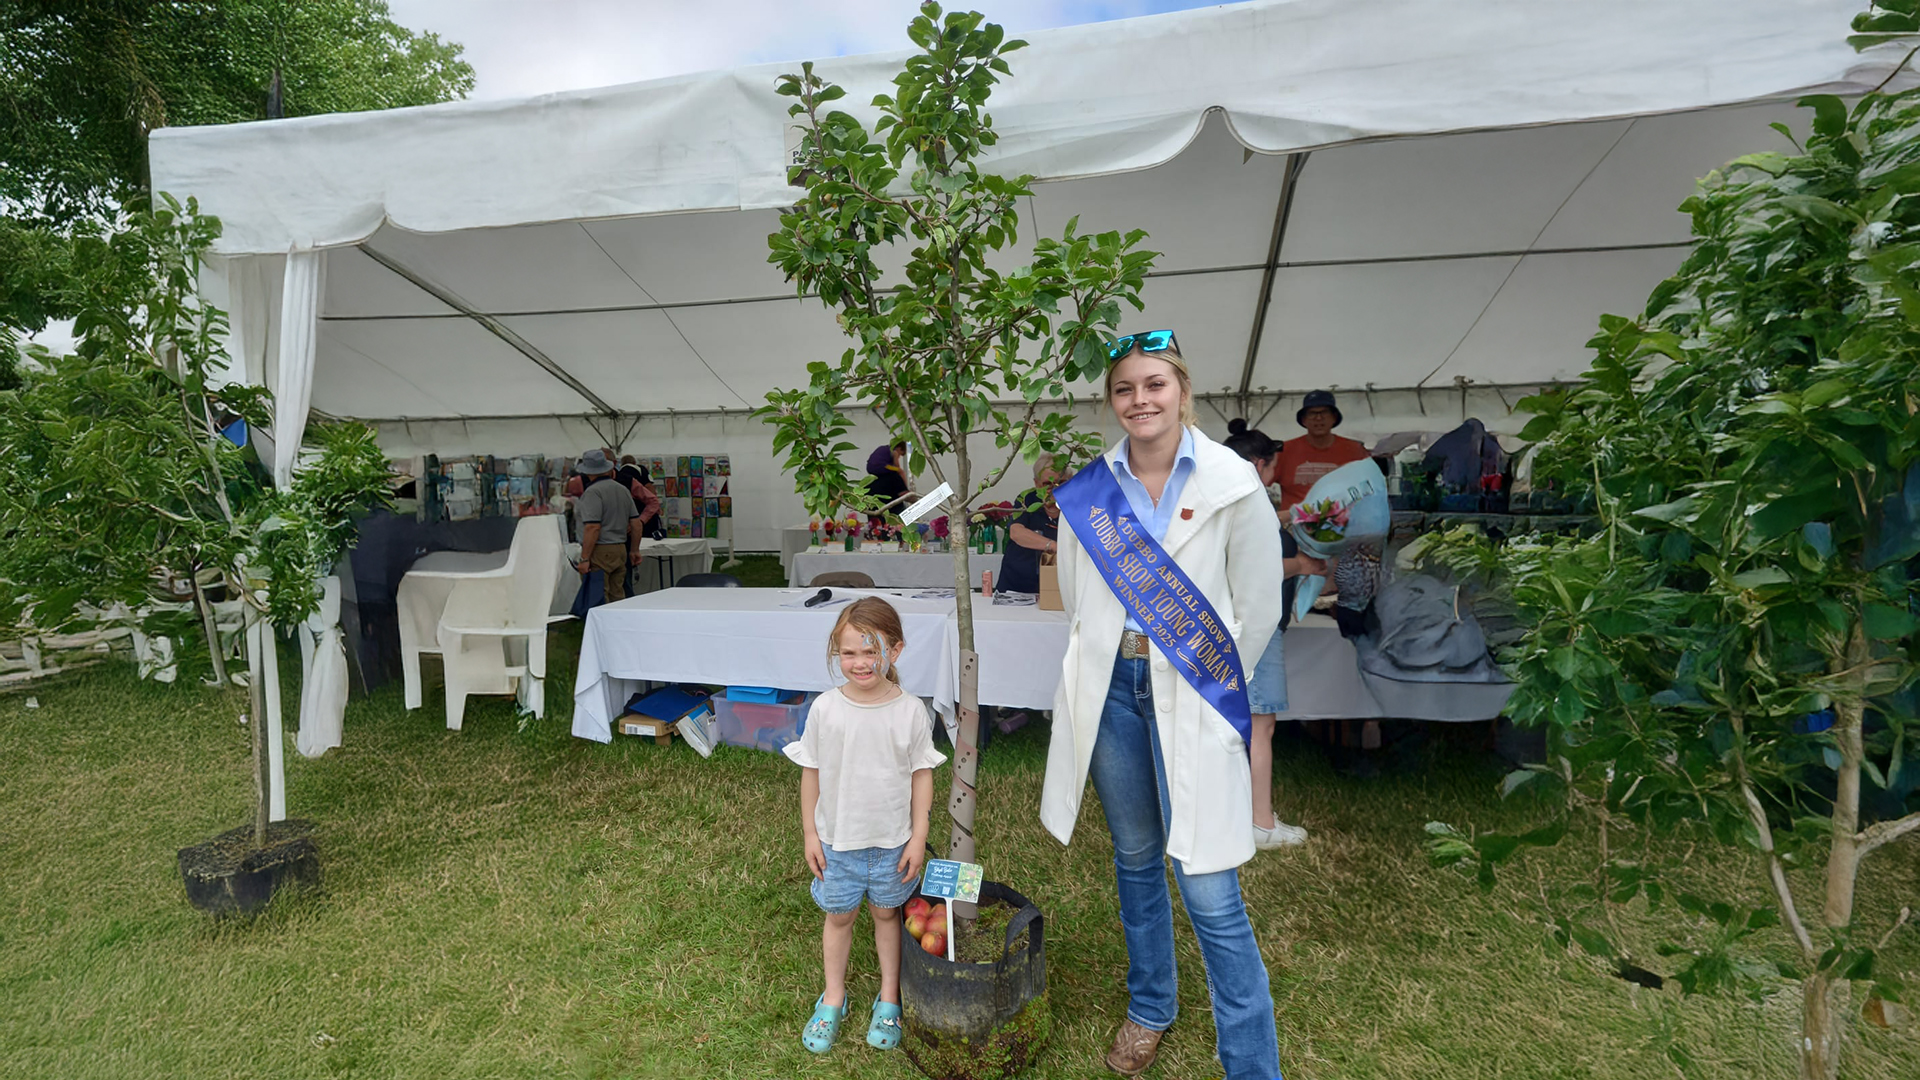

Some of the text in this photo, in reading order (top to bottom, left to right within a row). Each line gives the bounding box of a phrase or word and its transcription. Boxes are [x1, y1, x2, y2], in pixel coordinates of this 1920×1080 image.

[1091, 513, 1233, 684] DUBBO SHOW YOUNG WOMAN
[1113, 575, 1177, 648] WINNER 2025
[1122, 523, 1226, 645] DUBBO ANNUAL SHOW
